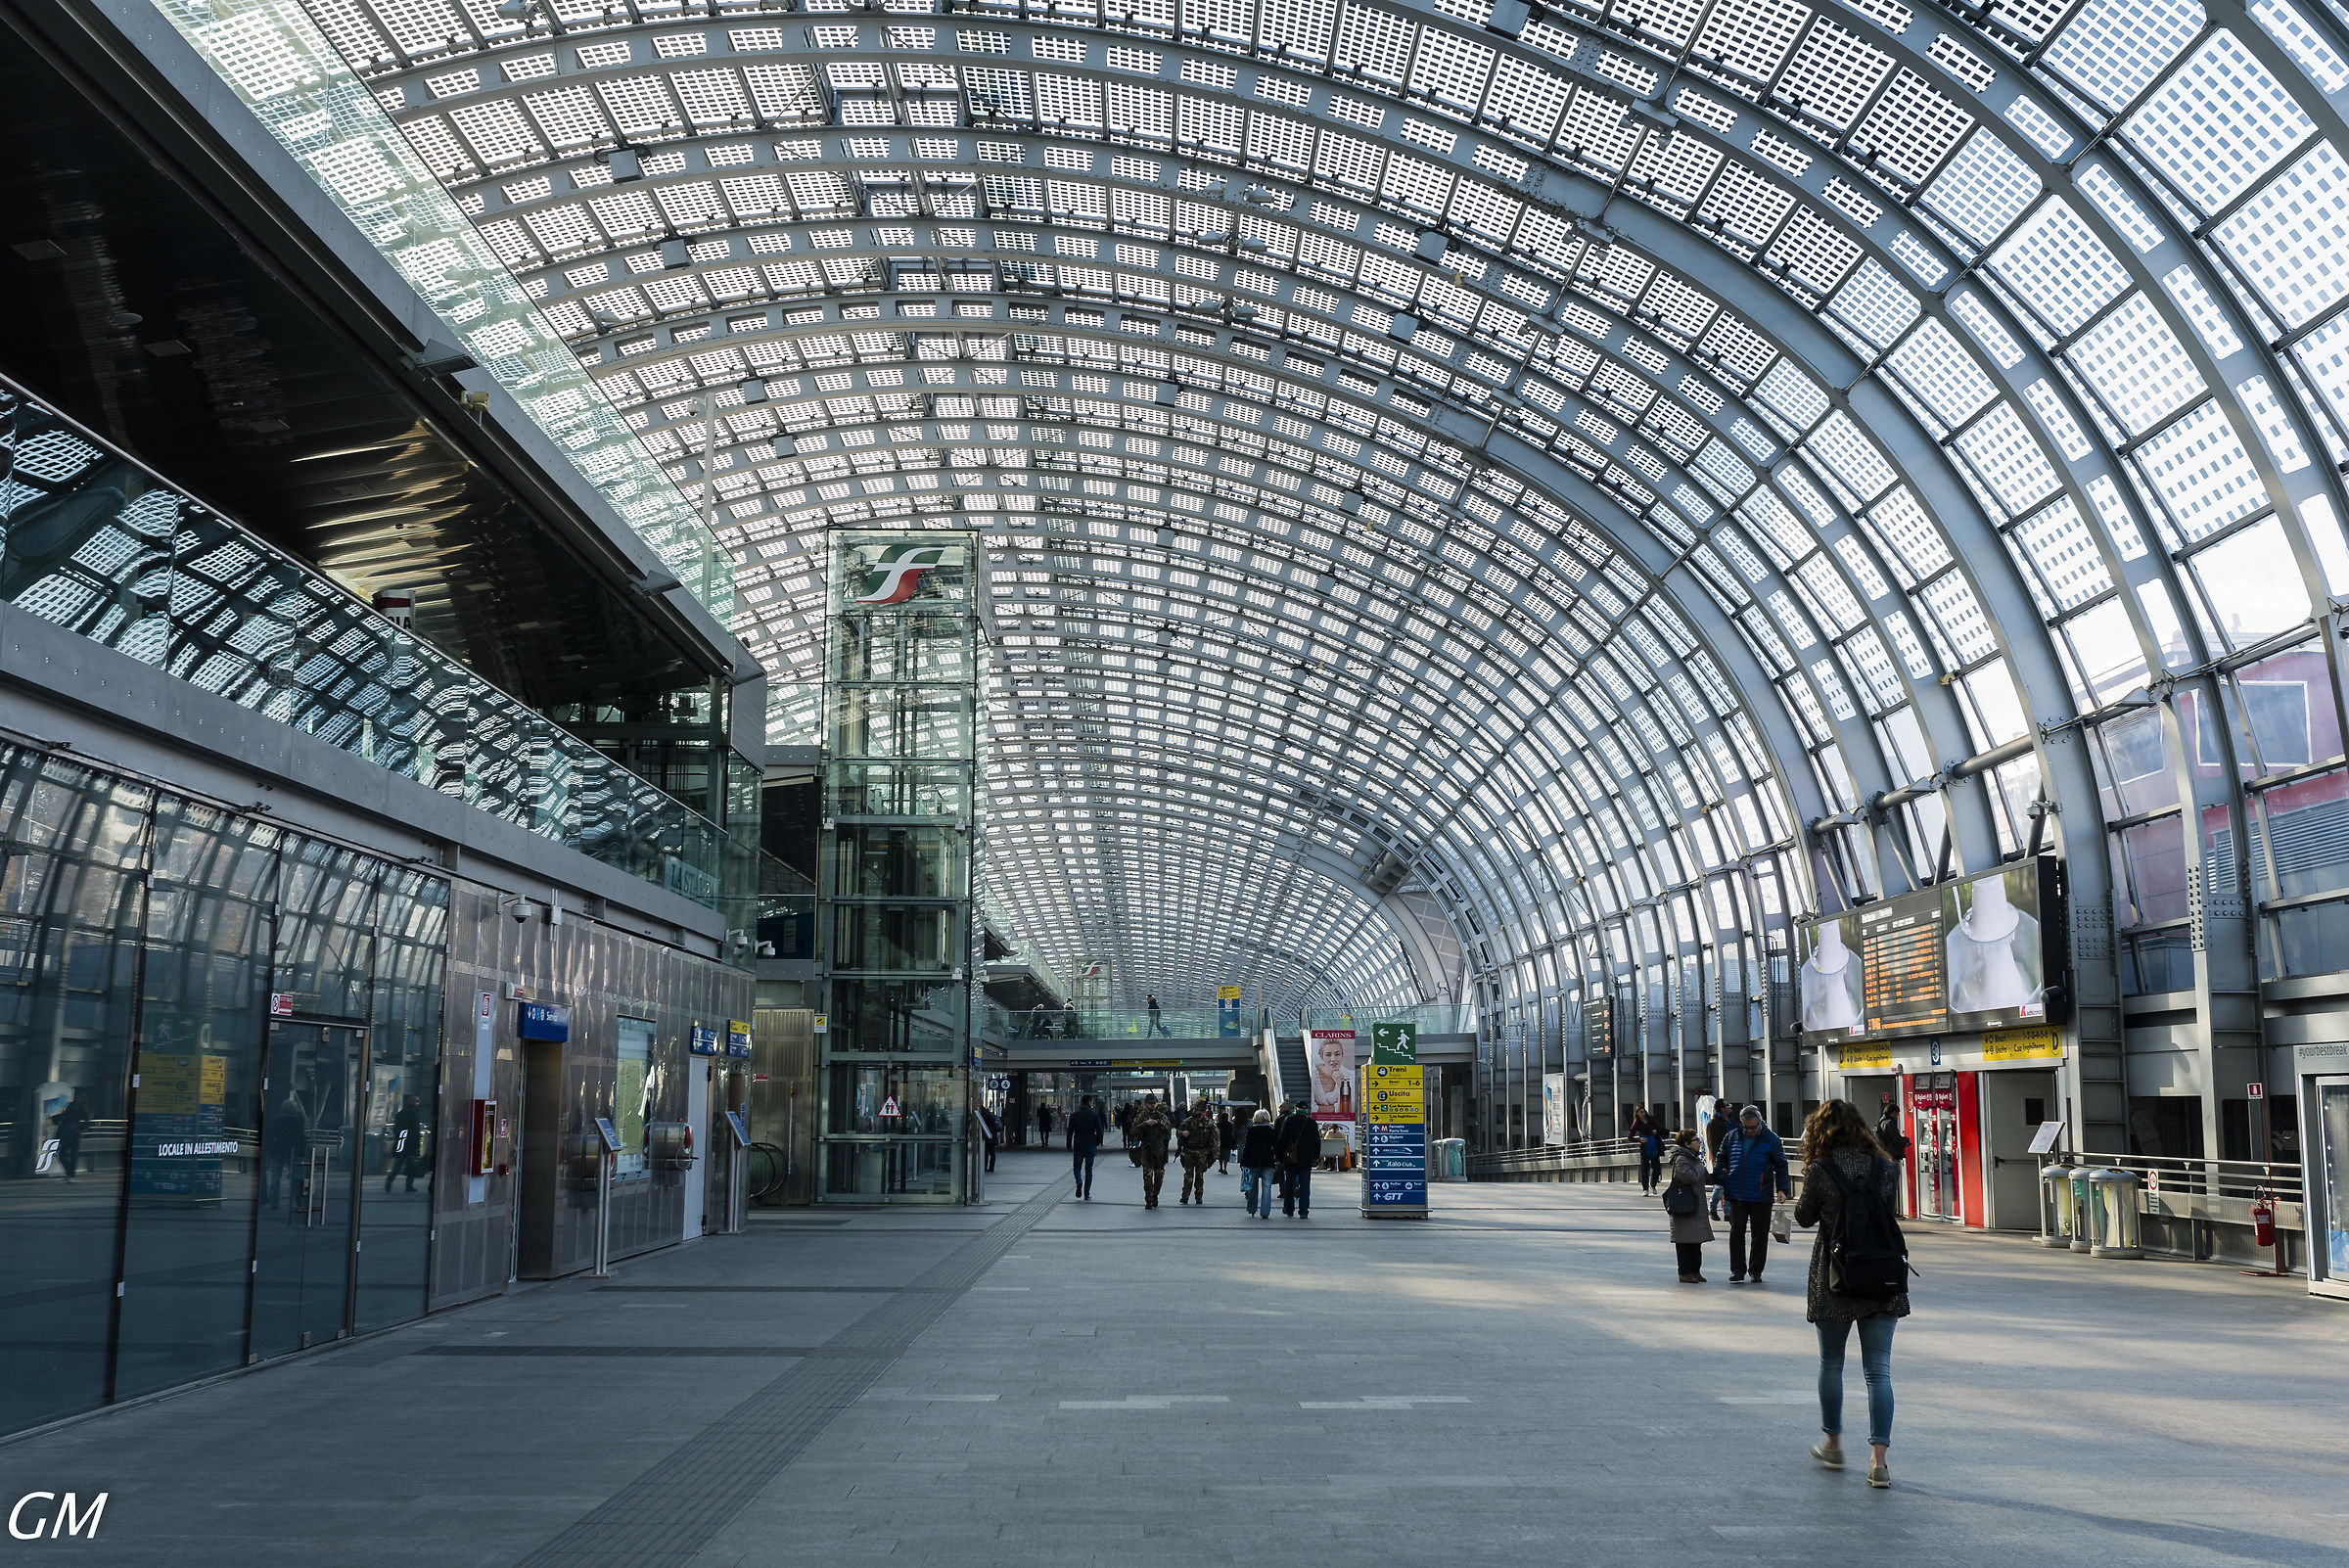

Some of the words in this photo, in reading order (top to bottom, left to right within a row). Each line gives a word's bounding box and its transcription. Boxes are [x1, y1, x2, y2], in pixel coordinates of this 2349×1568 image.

[2013, 1043, 2022, 1053] Cso
[2051, 1032, 2059, 1051] D
[2298, 1043, 2348, 1059] #yourbestbreak
[159, 1143, 184, 1157] LOCALE
[184, 1142, 194, 1155] IN
[194, 1140, 239, 1155] ALLESTIMENTO
[1383, 1192, 1404, 1201] GTT
